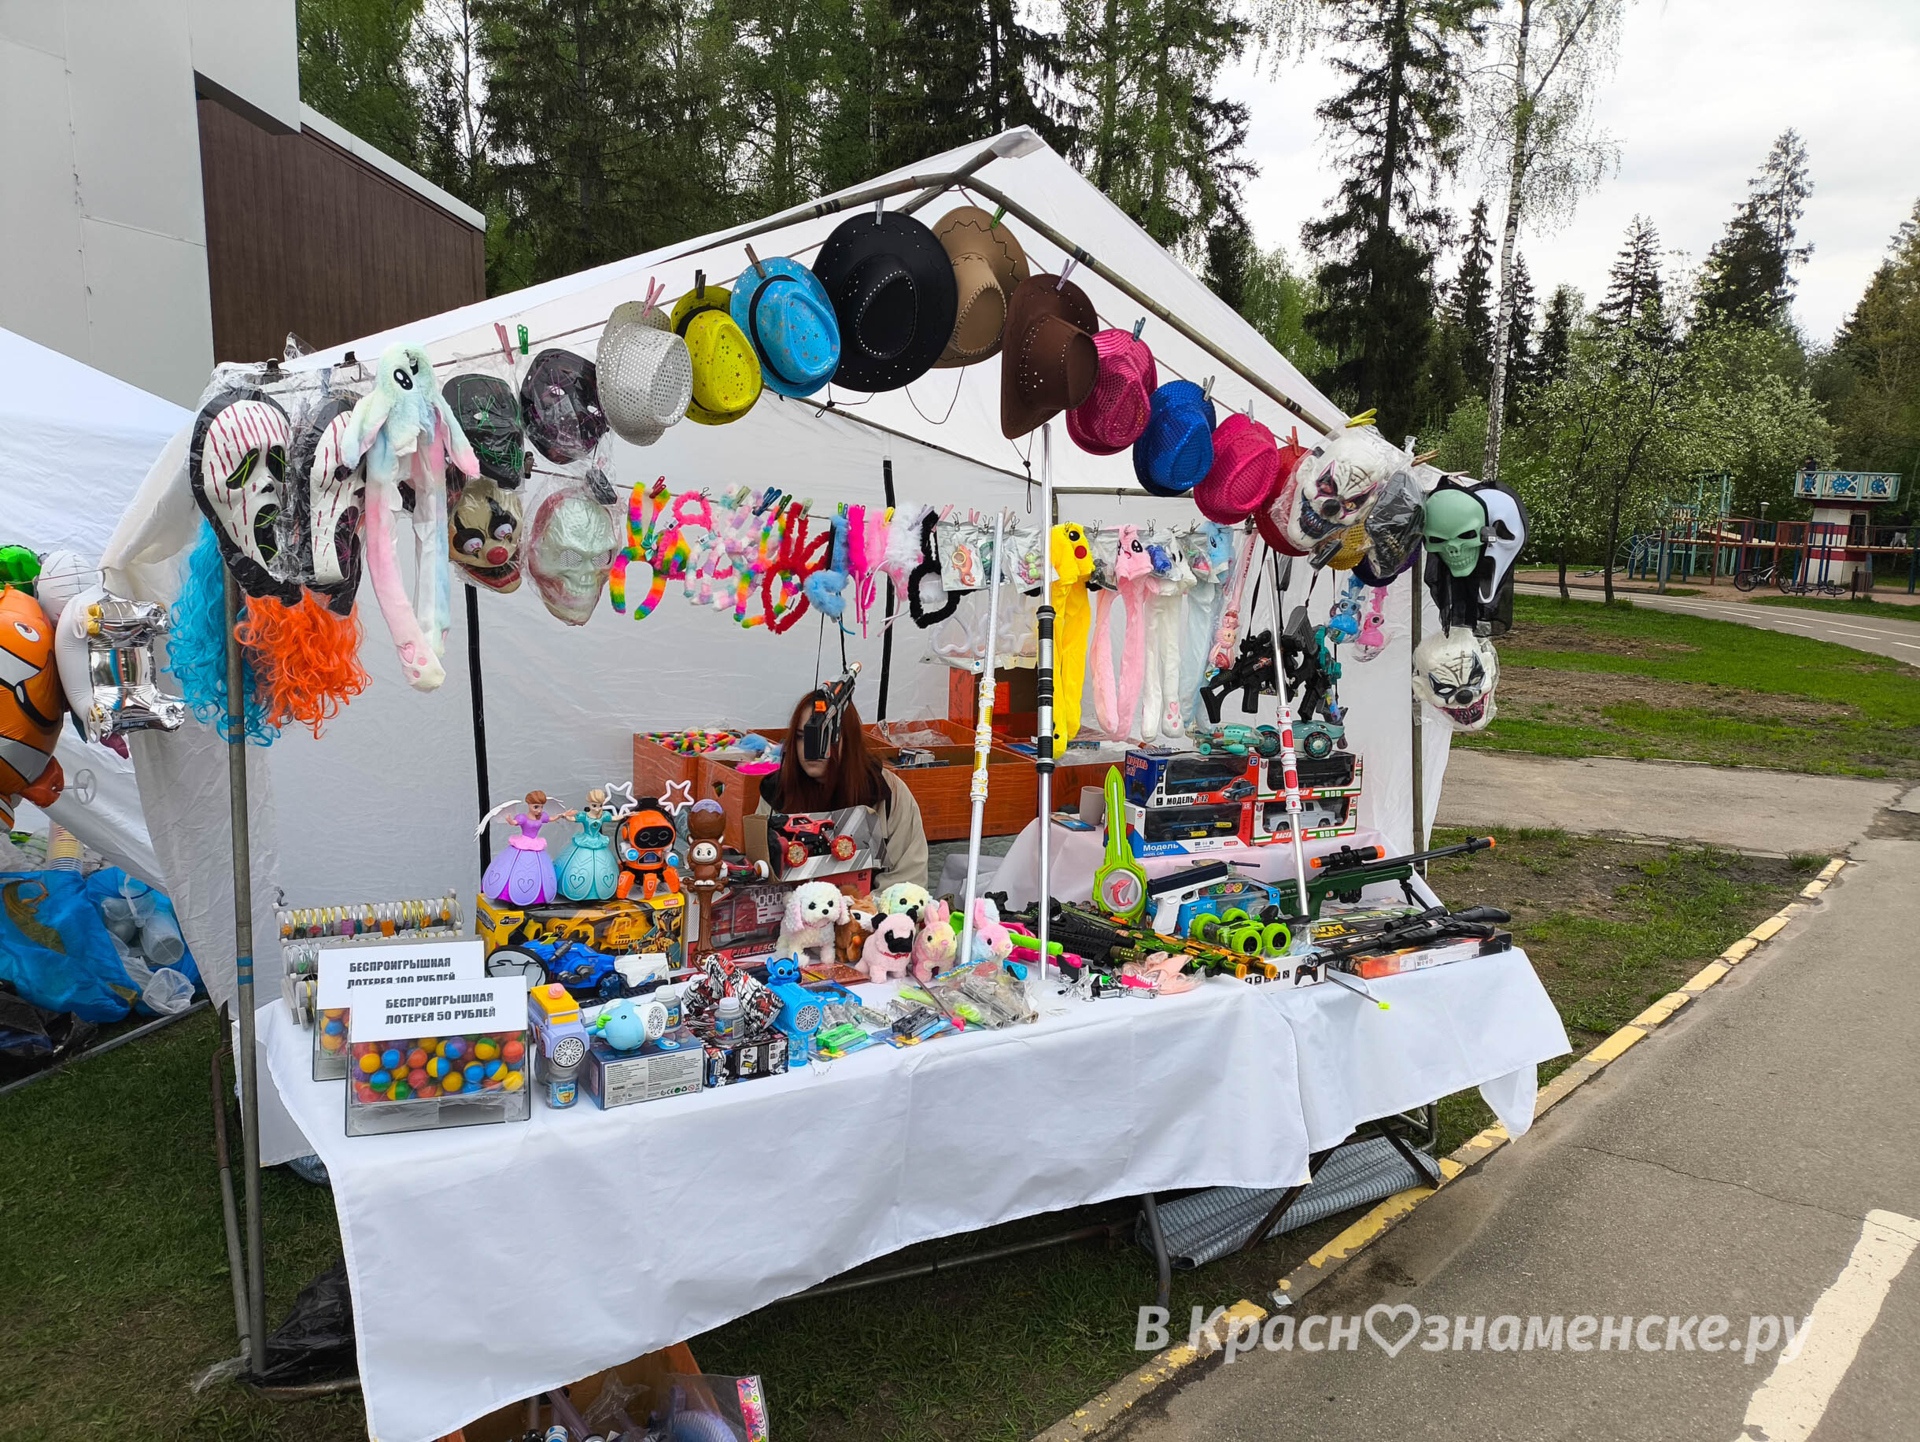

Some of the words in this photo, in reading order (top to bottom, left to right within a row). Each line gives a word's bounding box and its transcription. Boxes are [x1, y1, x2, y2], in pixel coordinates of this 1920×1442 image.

[1166, 796, 1194, 805] МОДЕЛЬ
[1143, 843, 1179, 852] Модель
[731, 946, 752, 956] FIRE
[349, 957, 451, 973] БЕСПРОИГРЫШНАЯ
[385, 992, 494, 1009] БЕСПРОИГРЫШНАЯ
[385, 1011, 434, 1025] ЛОТЕРЕЯ
[436, 1011, 451, 1021] 50
[454, 1006, 496, 1020] РУБЛЕЙ
